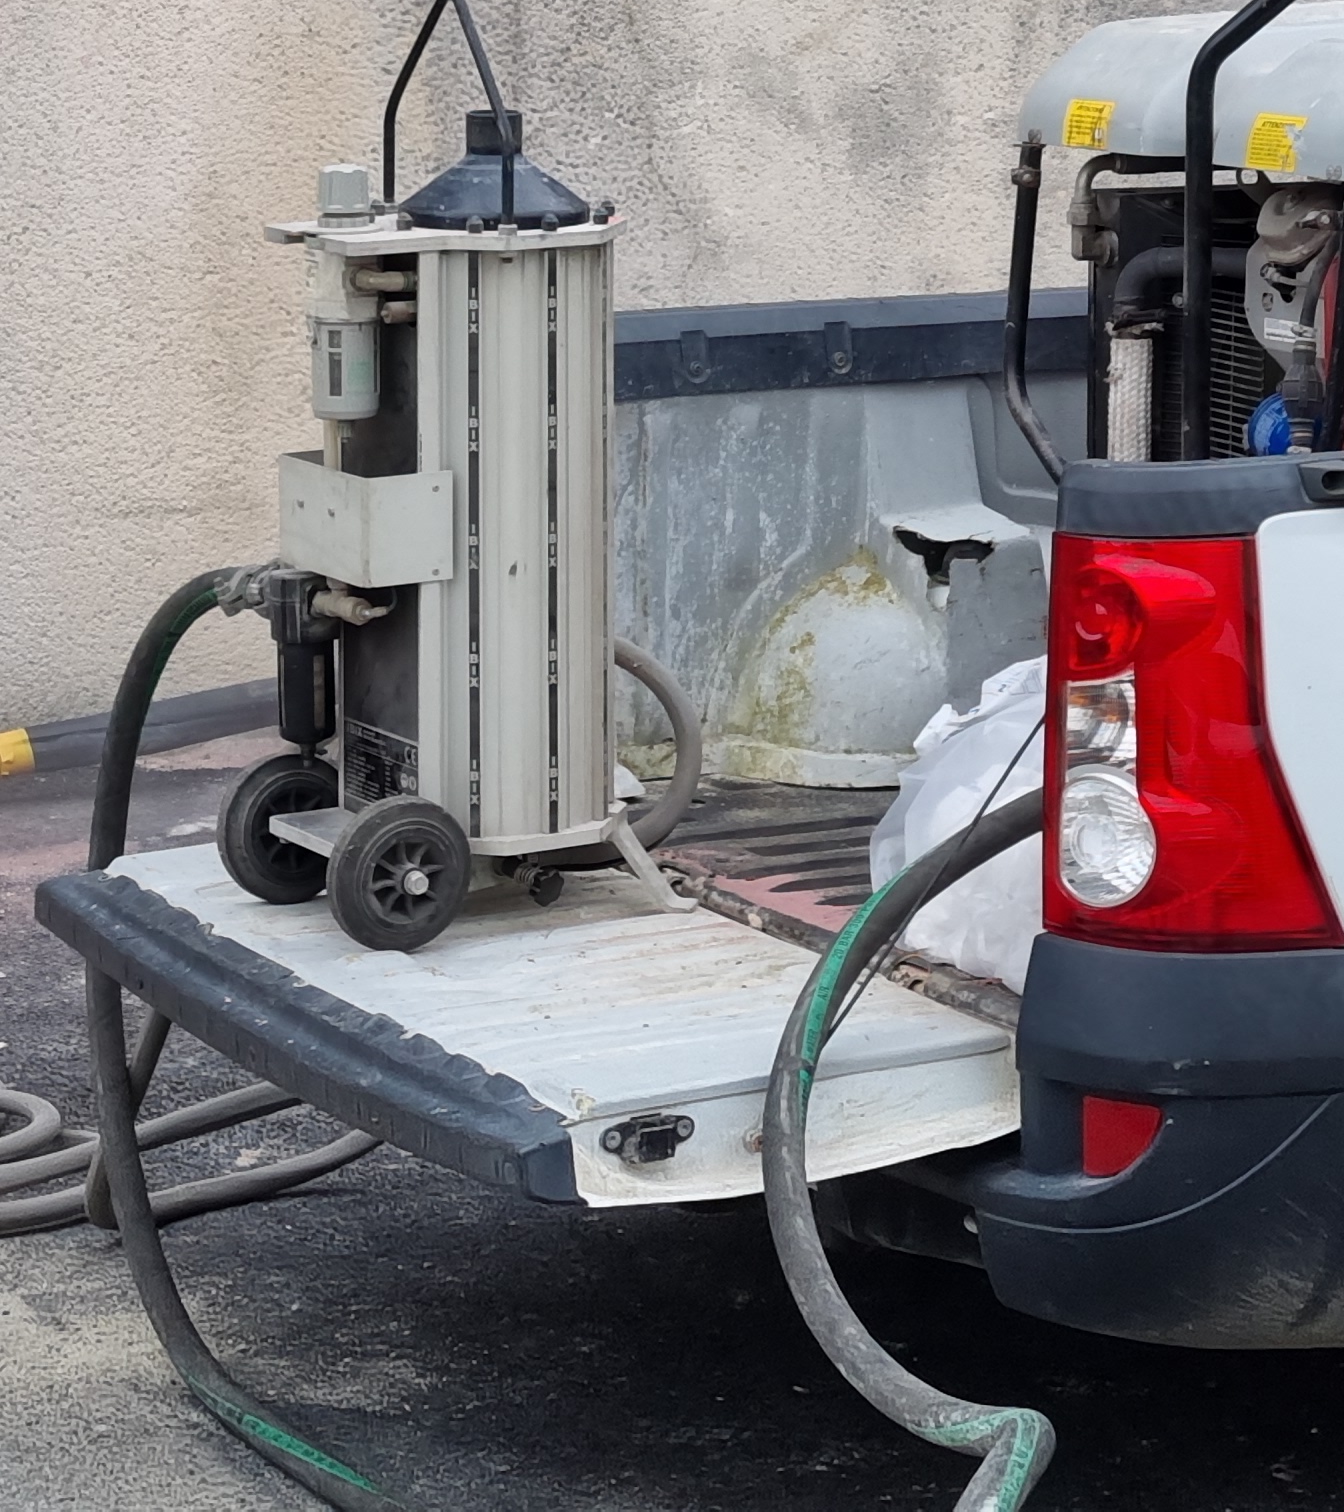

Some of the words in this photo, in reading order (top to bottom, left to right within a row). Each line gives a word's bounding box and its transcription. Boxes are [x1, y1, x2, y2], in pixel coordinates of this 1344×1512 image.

[468, 287, 479, 334] IBIX
[548, 286, 557, 332] IBIX
[468, 406, 479, 452] IBIX
[548, 404, 557, 450] IBIX
[548, 521, 557, 568] IBIX
[469, 641, 479, 688] IBIX
[548, 639, 558, 685] IBIX
[469, 759, 480, 805] IBIX
[549, 755, 559, 802] IBIX
[839, 929, 855, 947] BAR
